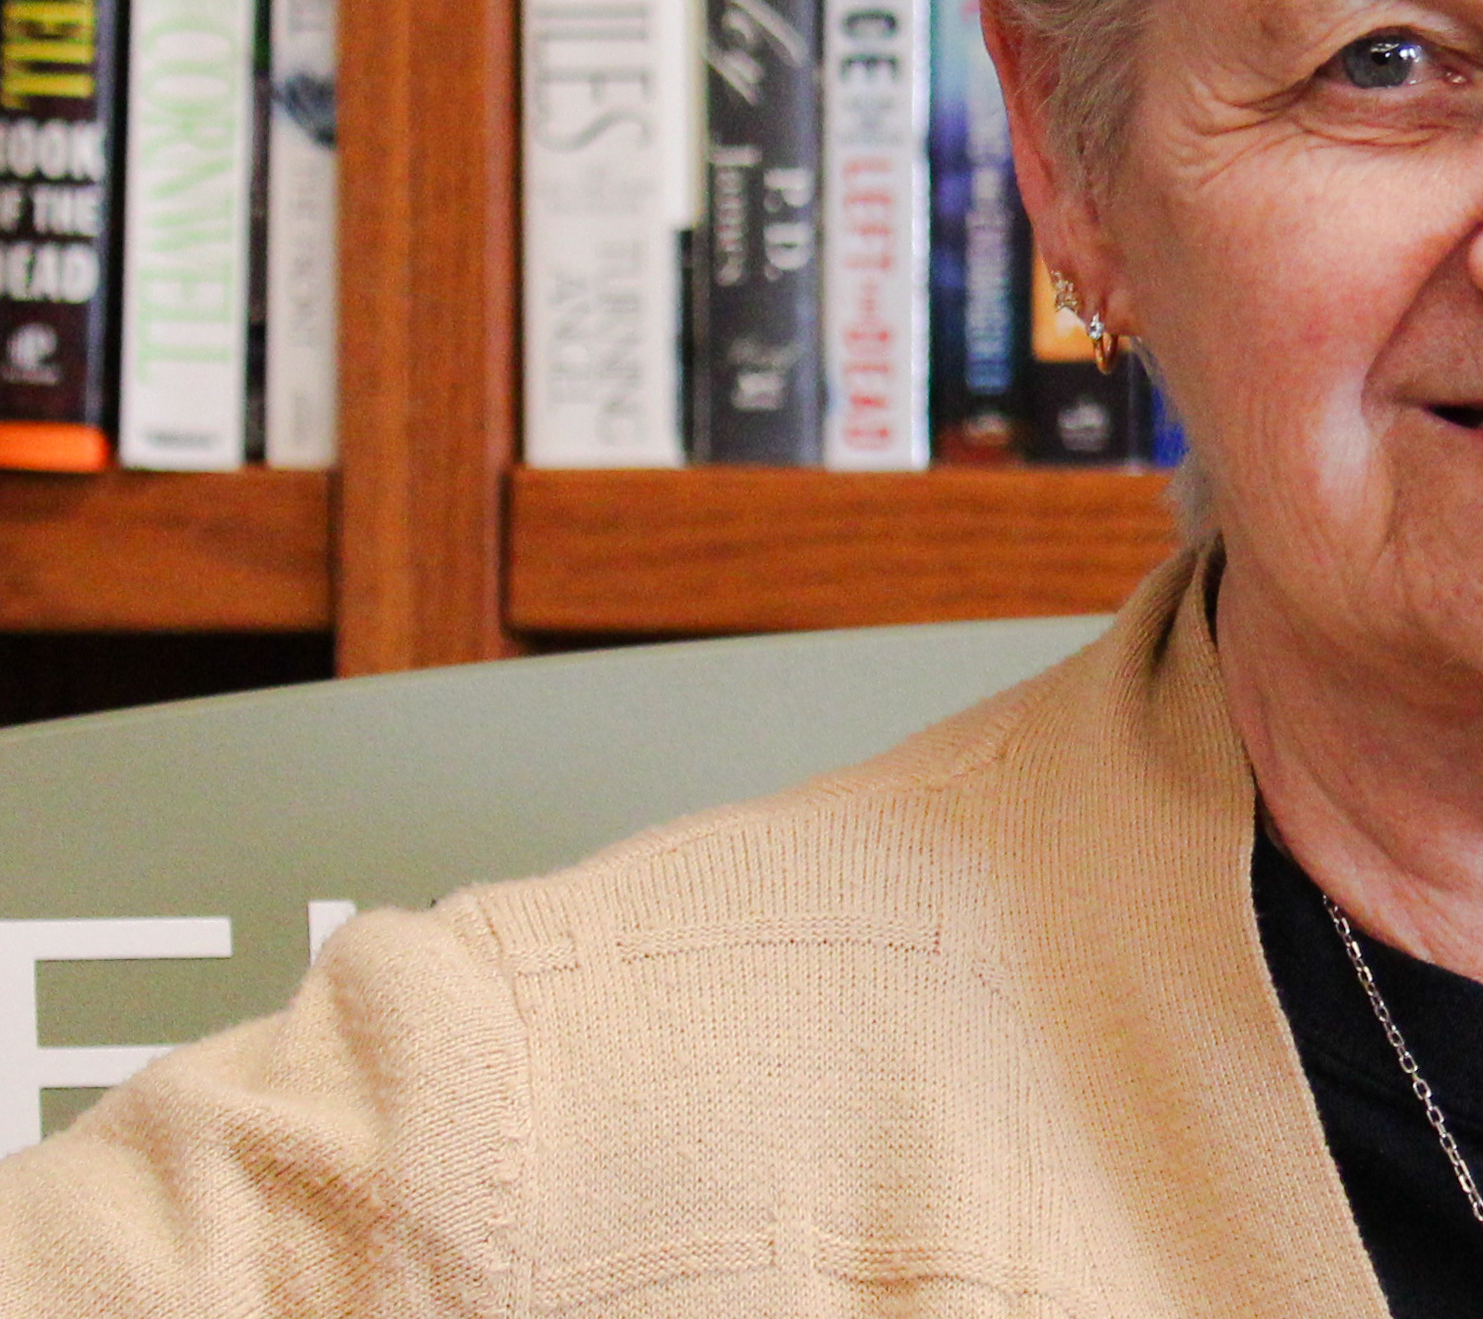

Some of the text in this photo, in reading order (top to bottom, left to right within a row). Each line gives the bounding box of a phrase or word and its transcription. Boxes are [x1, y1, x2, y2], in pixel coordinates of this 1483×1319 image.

[529, 0, 654, 152] ILES
[134, 21, 244, 387] CORNWELL
[701, 132, 763, 286] James
[840, 156, 897, 277] LEFT
[840, 325, 895, 454] DEAD
